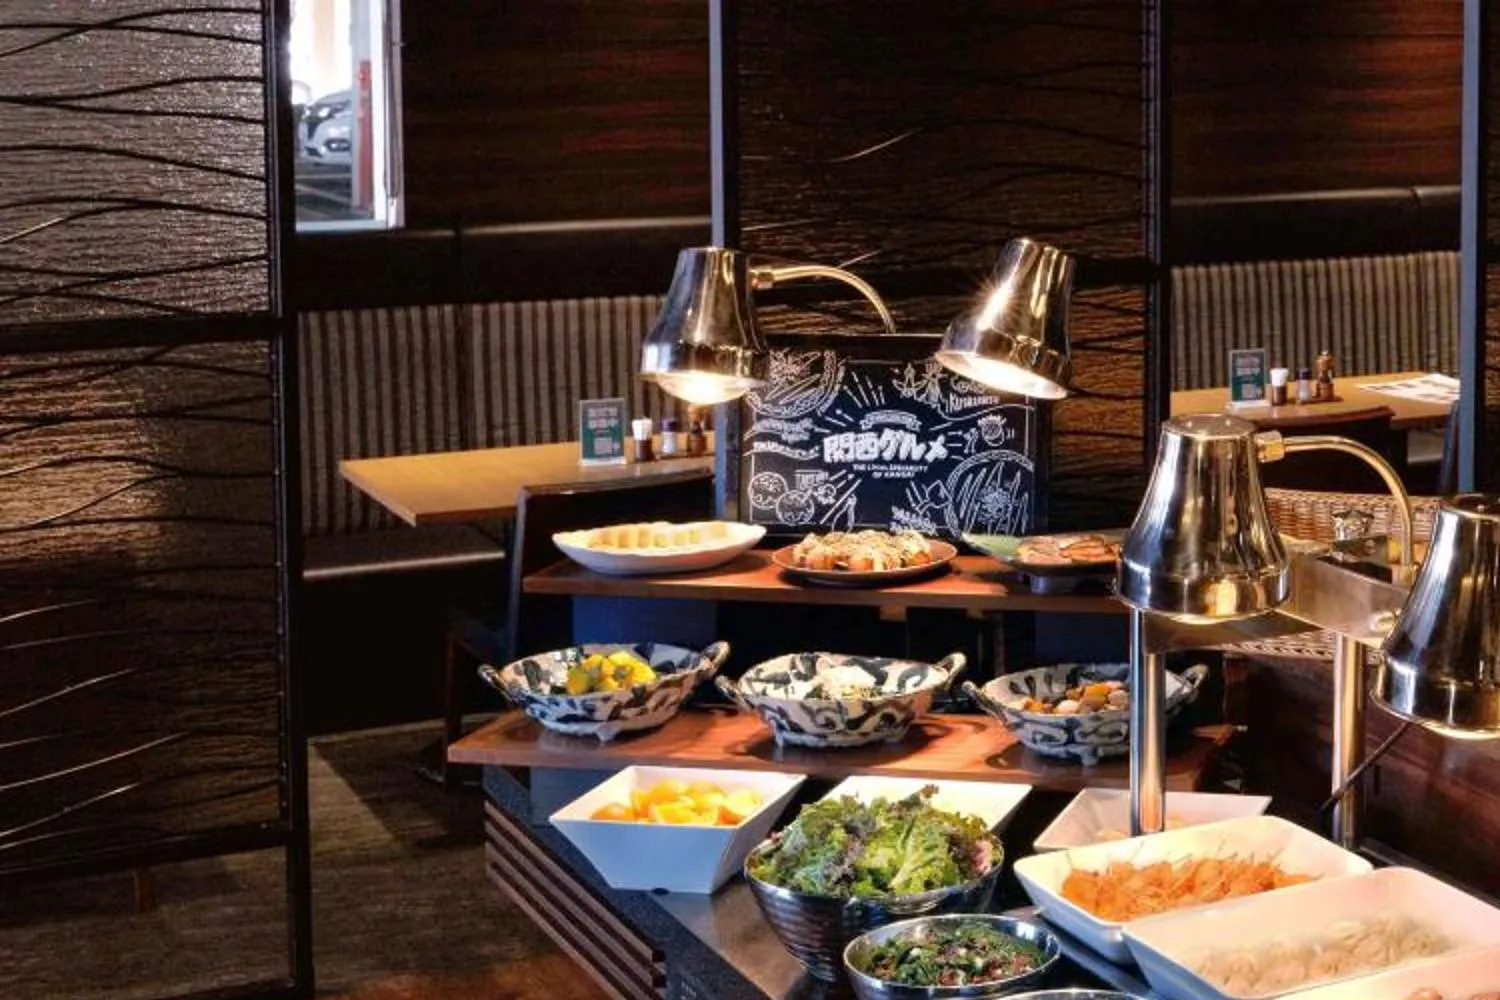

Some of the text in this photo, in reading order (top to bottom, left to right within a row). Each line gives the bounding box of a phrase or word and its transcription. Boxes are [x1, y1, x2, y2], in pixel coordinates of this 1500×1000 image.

[823, 428, 949, 463] 関西グルメ
